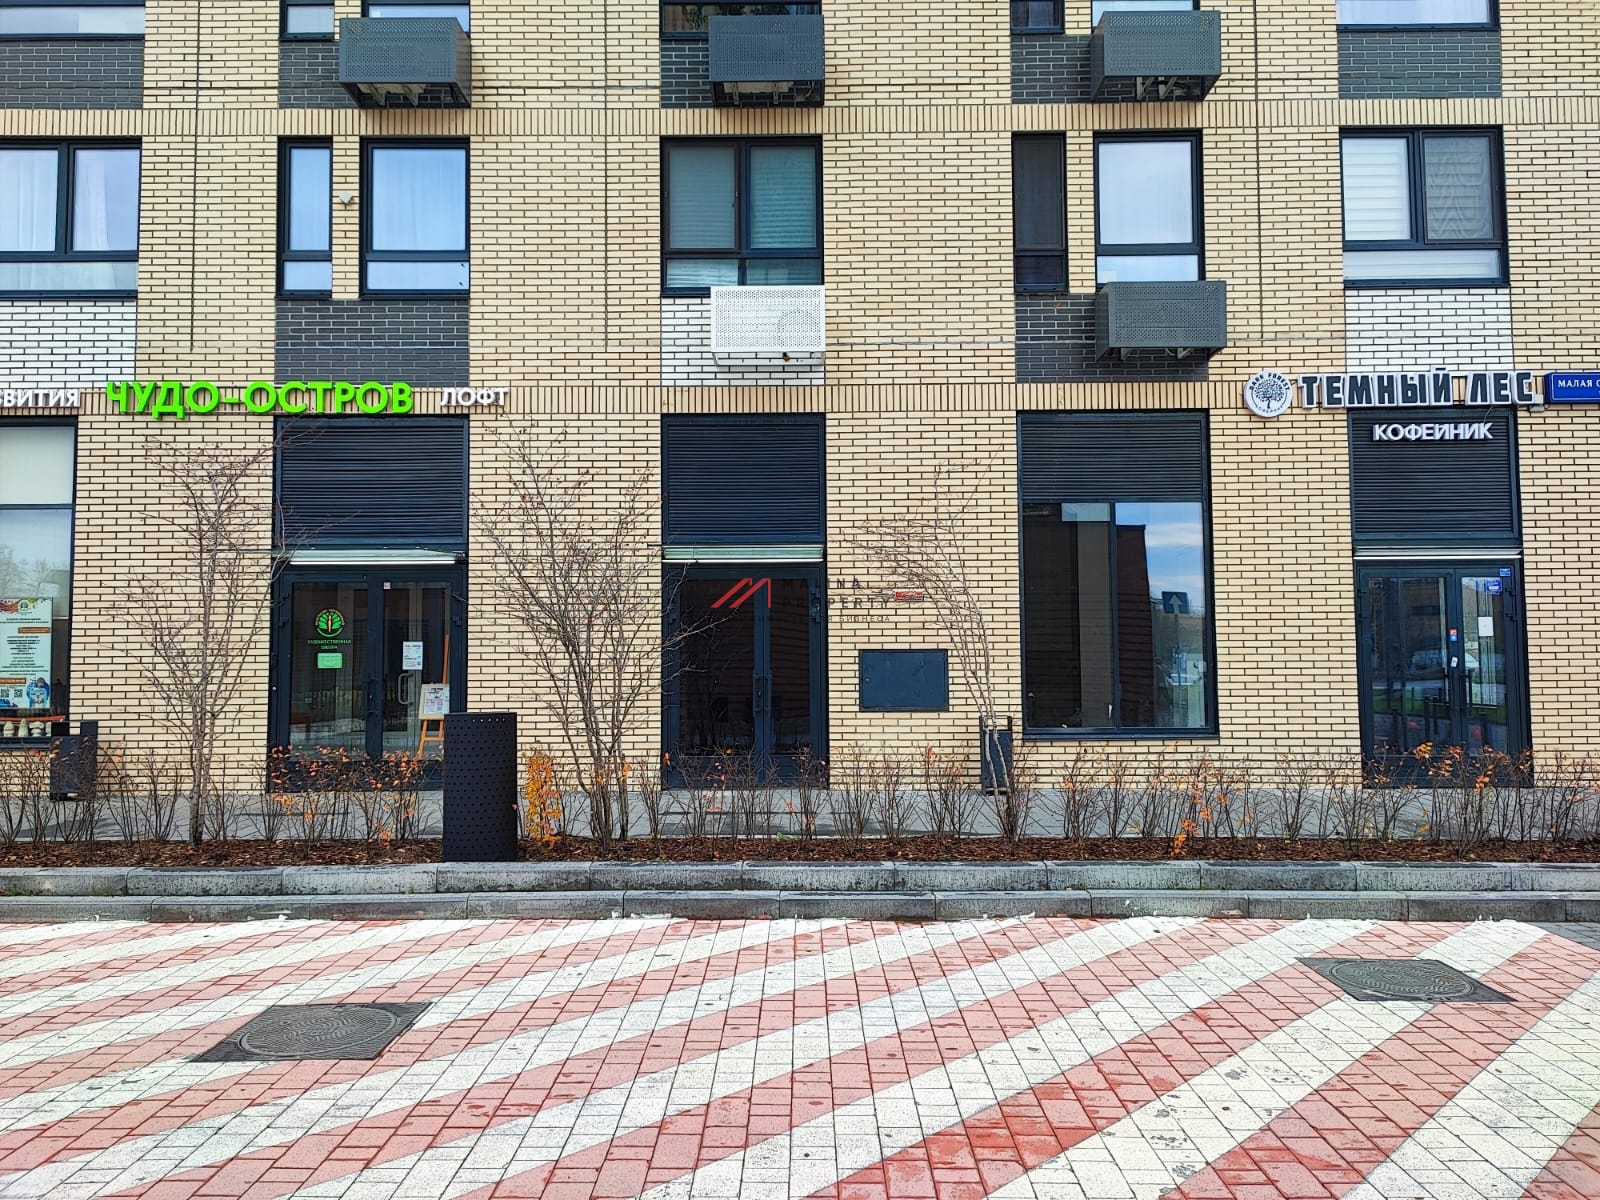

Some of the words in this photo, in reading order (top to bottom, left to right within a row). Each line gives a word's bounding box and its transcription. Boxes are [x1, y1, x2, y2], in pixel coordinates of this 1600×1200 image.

[1268, 372, 1290, 391] FOREST
[1300, 367, 1451, 406] ТЕМНЫЙ
[1468, 371, 1534, 404] ЛЕС
[1558, 379, 1593, 388] МАЛАЯ
[106, 381, 413, 419] ЧУДО-ОСТРОВ
[440, 387, 508, 406] ЛОФТ
